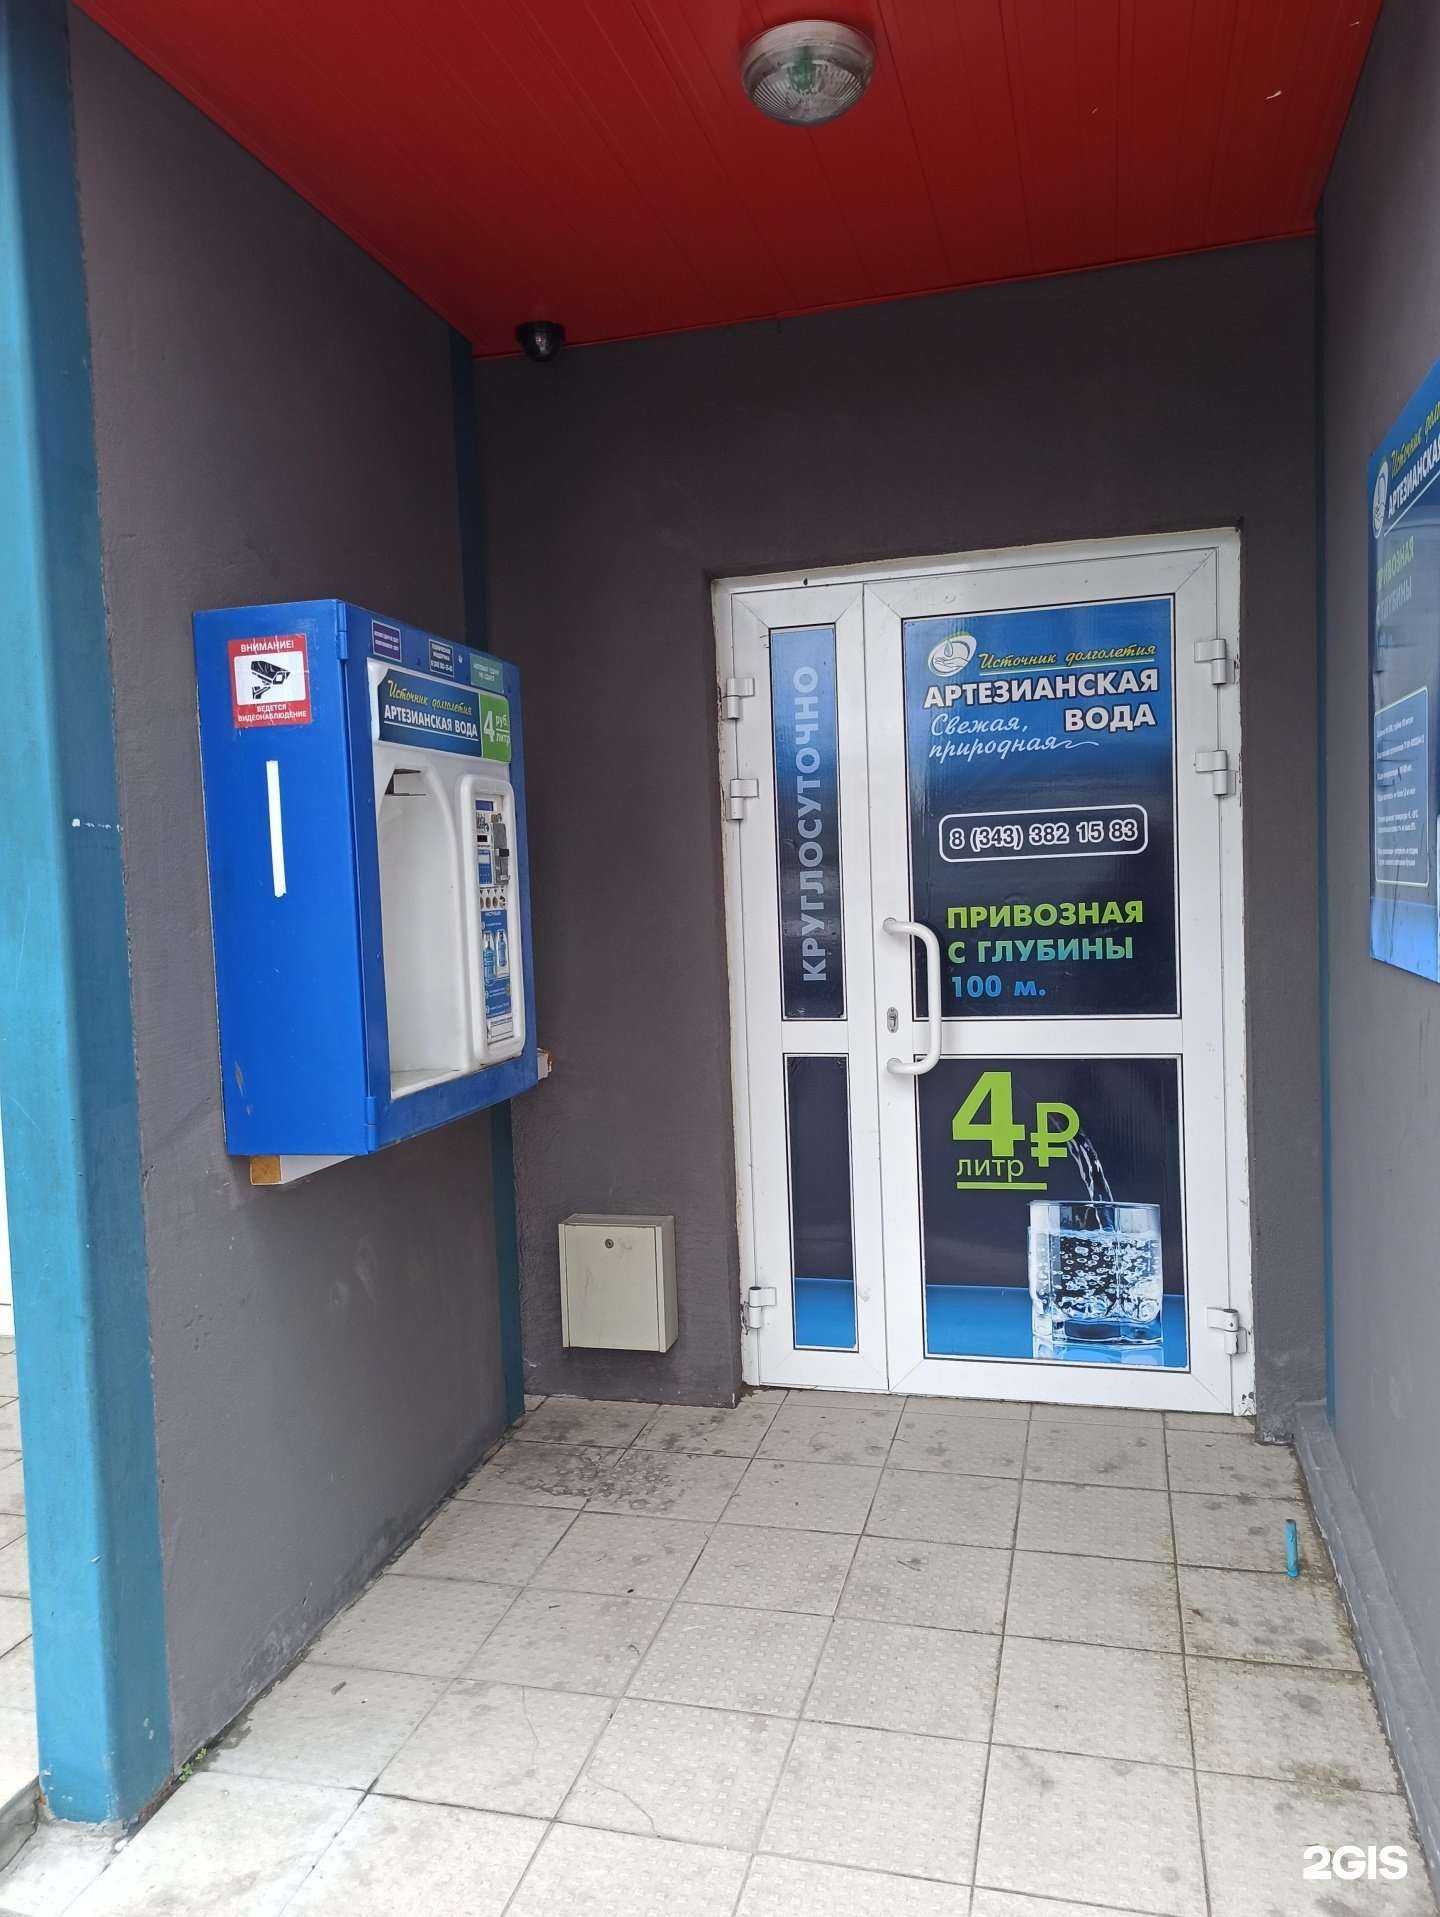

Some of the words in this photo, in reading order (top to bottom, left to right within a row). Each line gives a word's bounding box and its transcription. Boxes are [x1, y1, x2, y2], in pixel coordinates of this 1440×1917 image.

[240, 639, 294, 653] ВНИМАНИЕ!
[978, 653, 1057, 669] Источник
[1065, 643, 1158, 666] долголетия
[923, 668, 1159, 709] АРТЕЗИАНСКАЯ
[384, 704, 453, 732] АРТЕЗИАНСКАЯ
[454, 719, 478, 738] ВОДА
[483, 710, 495, 742] 4
[930, 714, 1029, 737] Свежая,
[1065, 703, 1156, 732] ВОДА
[928, 736, 1064, 765] природная
[793, 666, 827, 982] КРУГЛОСУТОЧНО
[949, 828, 965, 850] 8
[970, 825, 1024, 852] (343)
[1029, 823, 1070, 845] 382
[1076, 821, 1104, 843] 15
[1109, 819, 1138, 841] 83
[947, 900, 1144, 929] ПРИВОЗНАЯ
[948, 941, 966, 964] С
[977, 937, 1133, 963] ГЛУБИНЫ
[952, 975, 1001, 998] 100
[1014, 981, 1047, 997] м.
[956, 1159, 1024, 1183] литр
